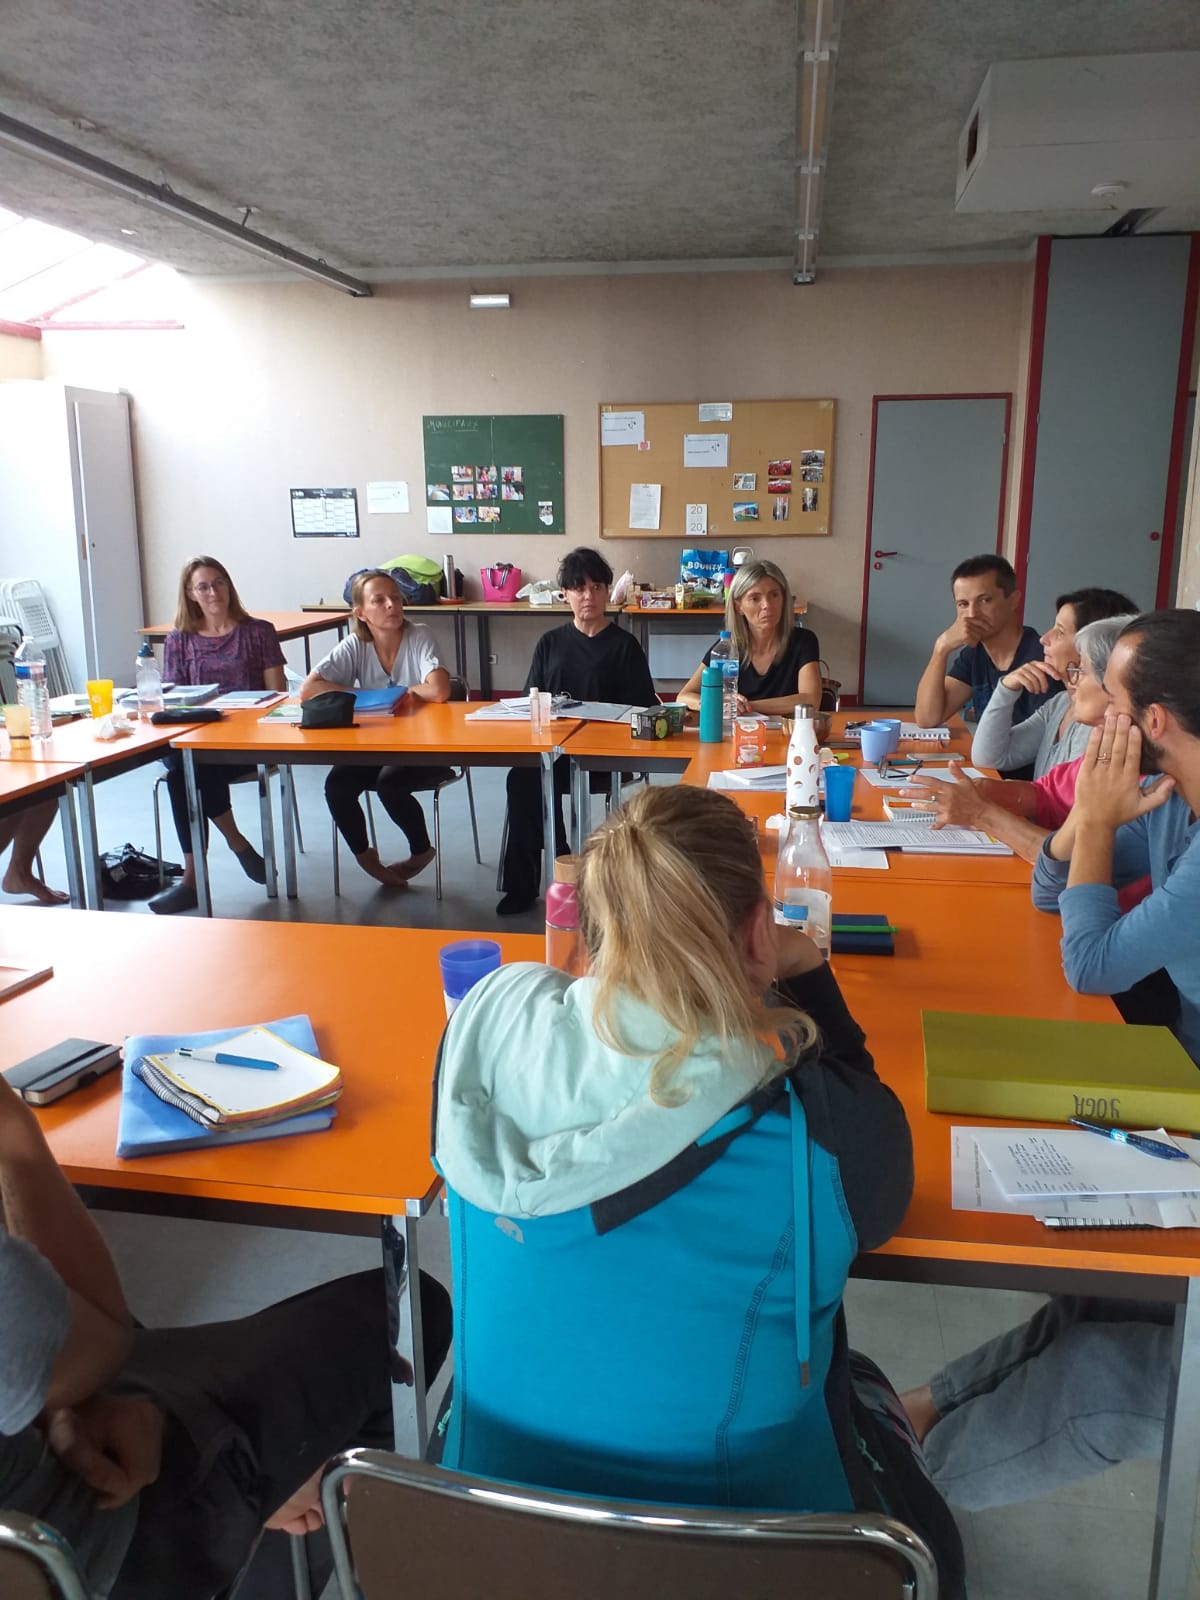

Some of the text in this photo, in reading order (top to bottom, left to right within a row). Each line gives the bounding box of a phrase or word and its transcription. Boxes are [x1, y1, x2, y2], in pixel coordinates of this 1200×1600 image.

[690, 505, 703, 515] 20
[690, 522, 703, 532] 20
[687, 561, 723, 571] BOUNTY
[1073, 1094, 1120, 1120] YOGA
